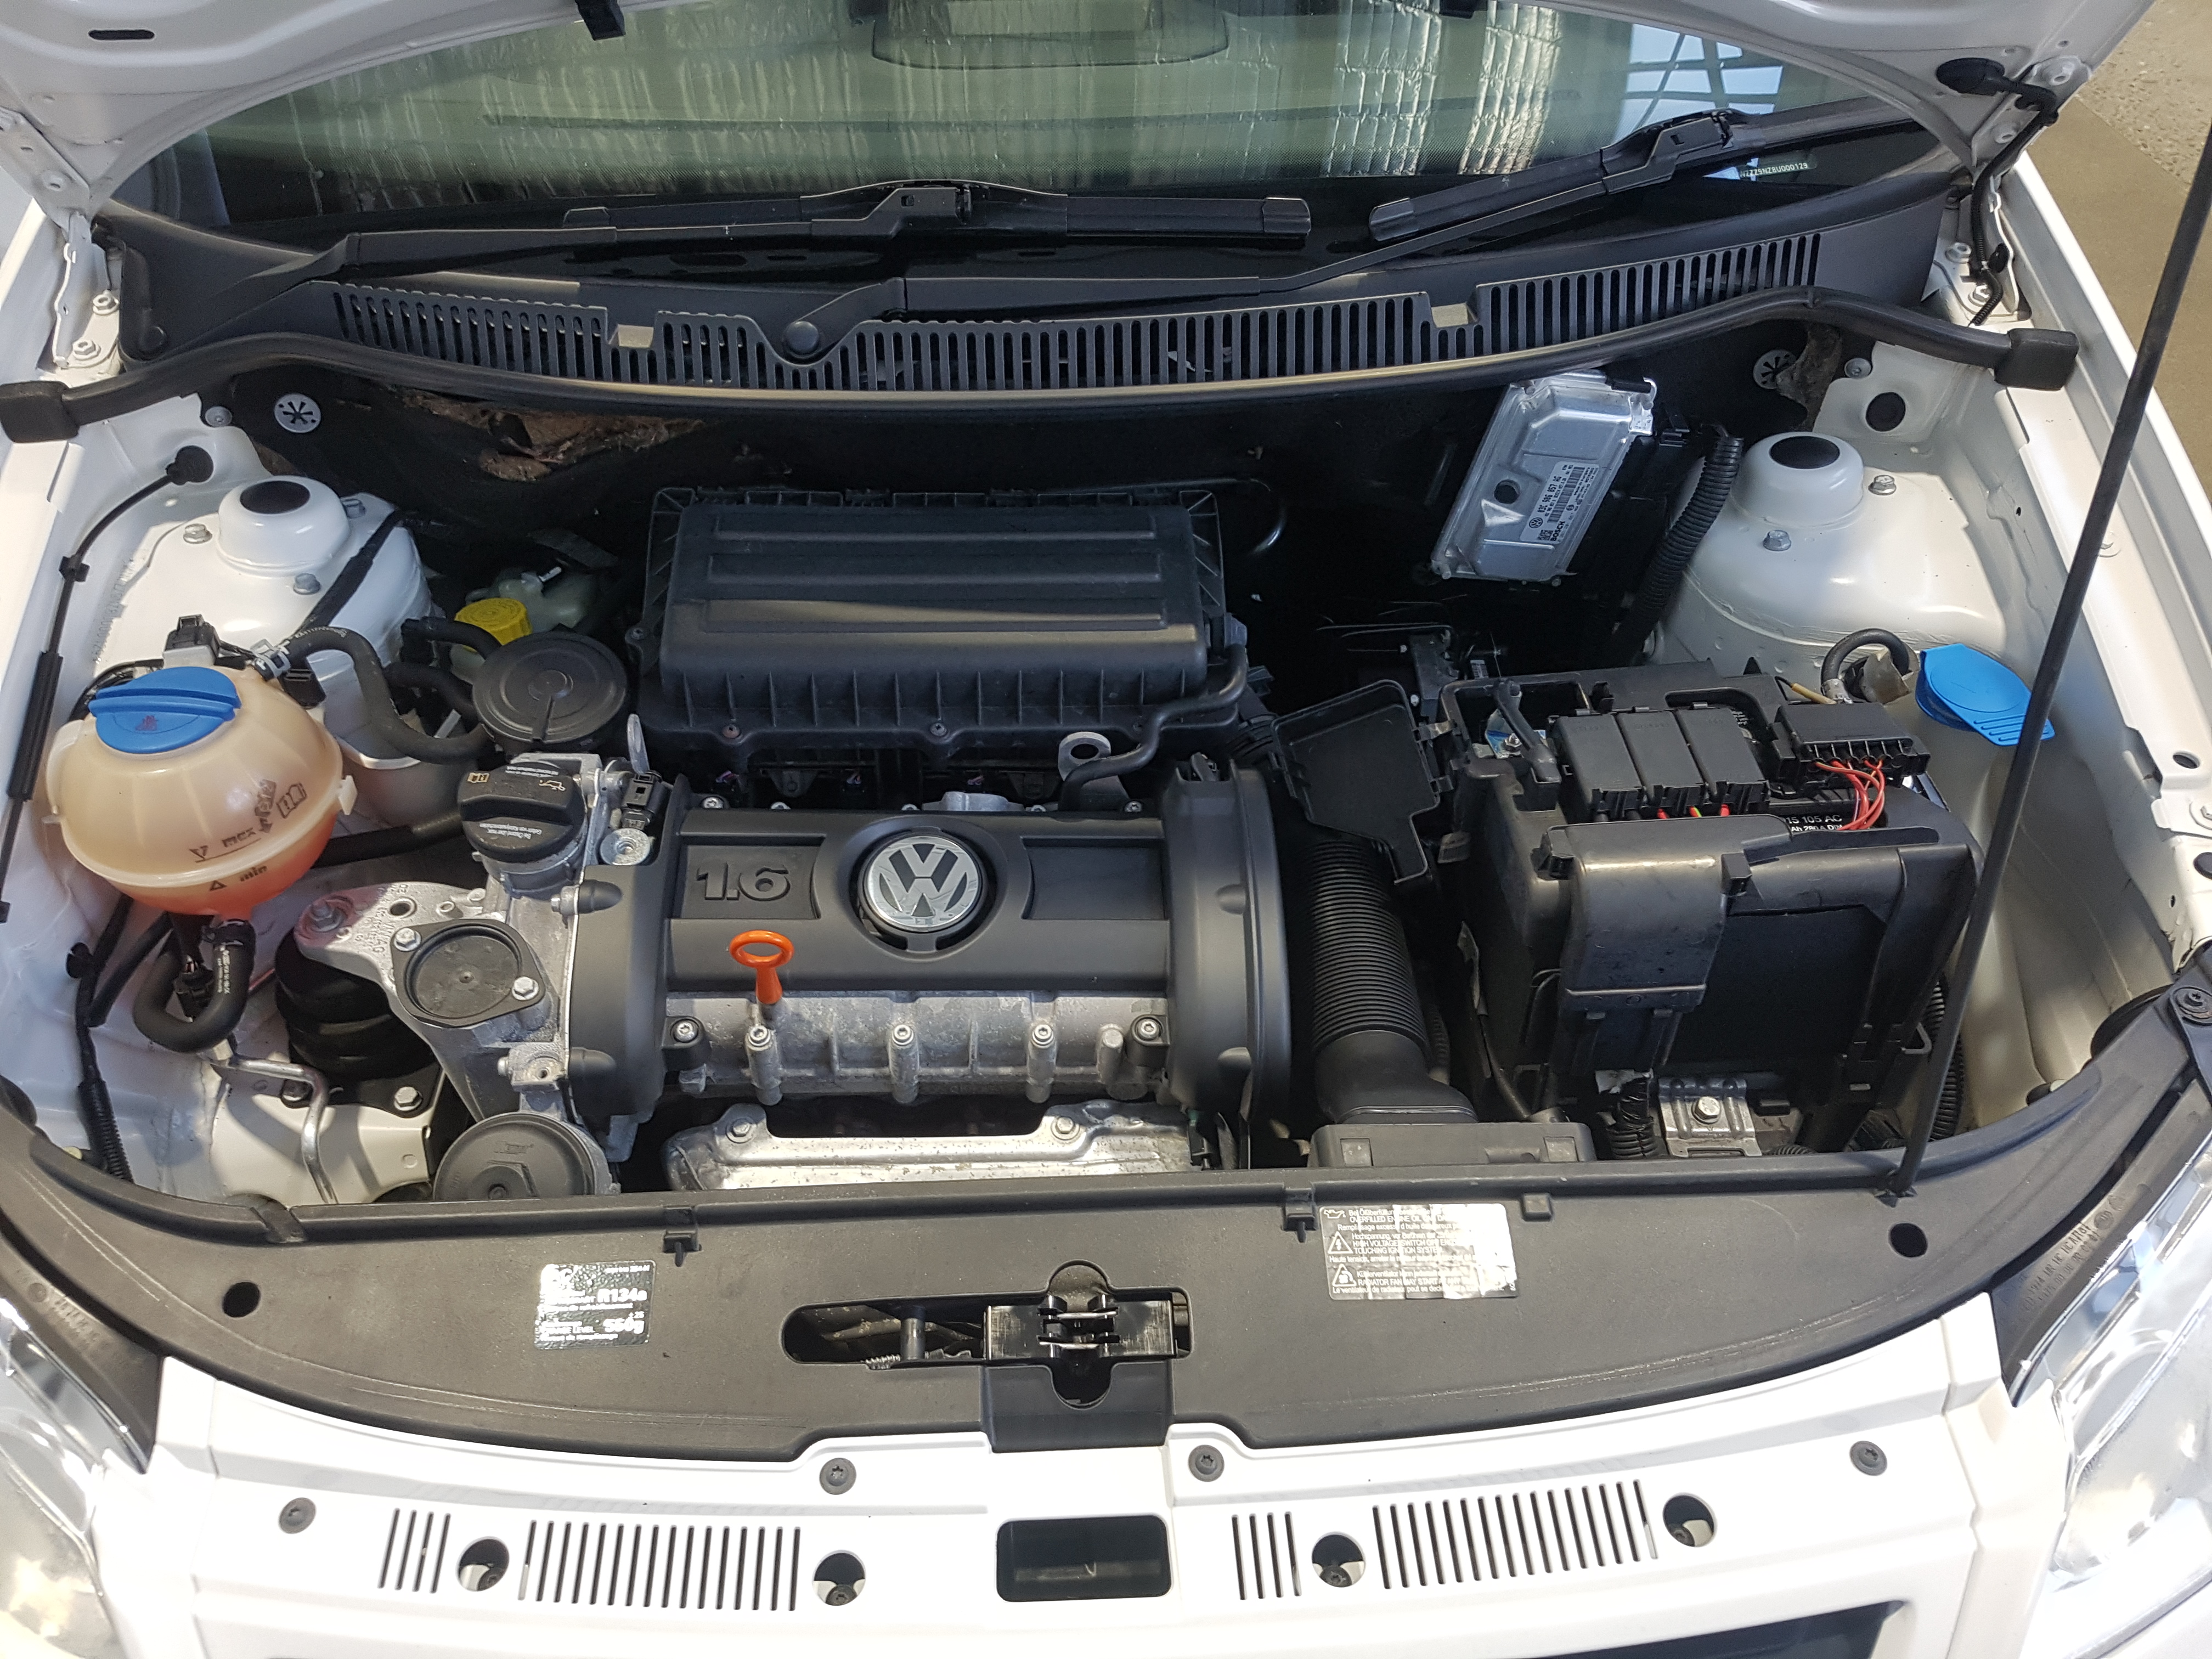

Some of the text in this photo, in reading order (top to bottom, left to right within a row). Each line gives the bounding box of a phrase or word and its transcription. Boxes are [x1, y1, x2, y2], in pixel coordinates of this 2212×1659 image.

[1550, 521, 1566, 541] BOSCH
[1801, 815, 1822, 823] 105
[1825, 814, 1842, 822] AC
[222, 827, 256, 848] max
[240, 866, 267, 882] min
[696, 862, 791, 901] 1.6
[866, 835, 980, 929] VW
[1359, 1208, 1397, 1216] Ölüberfüllun
